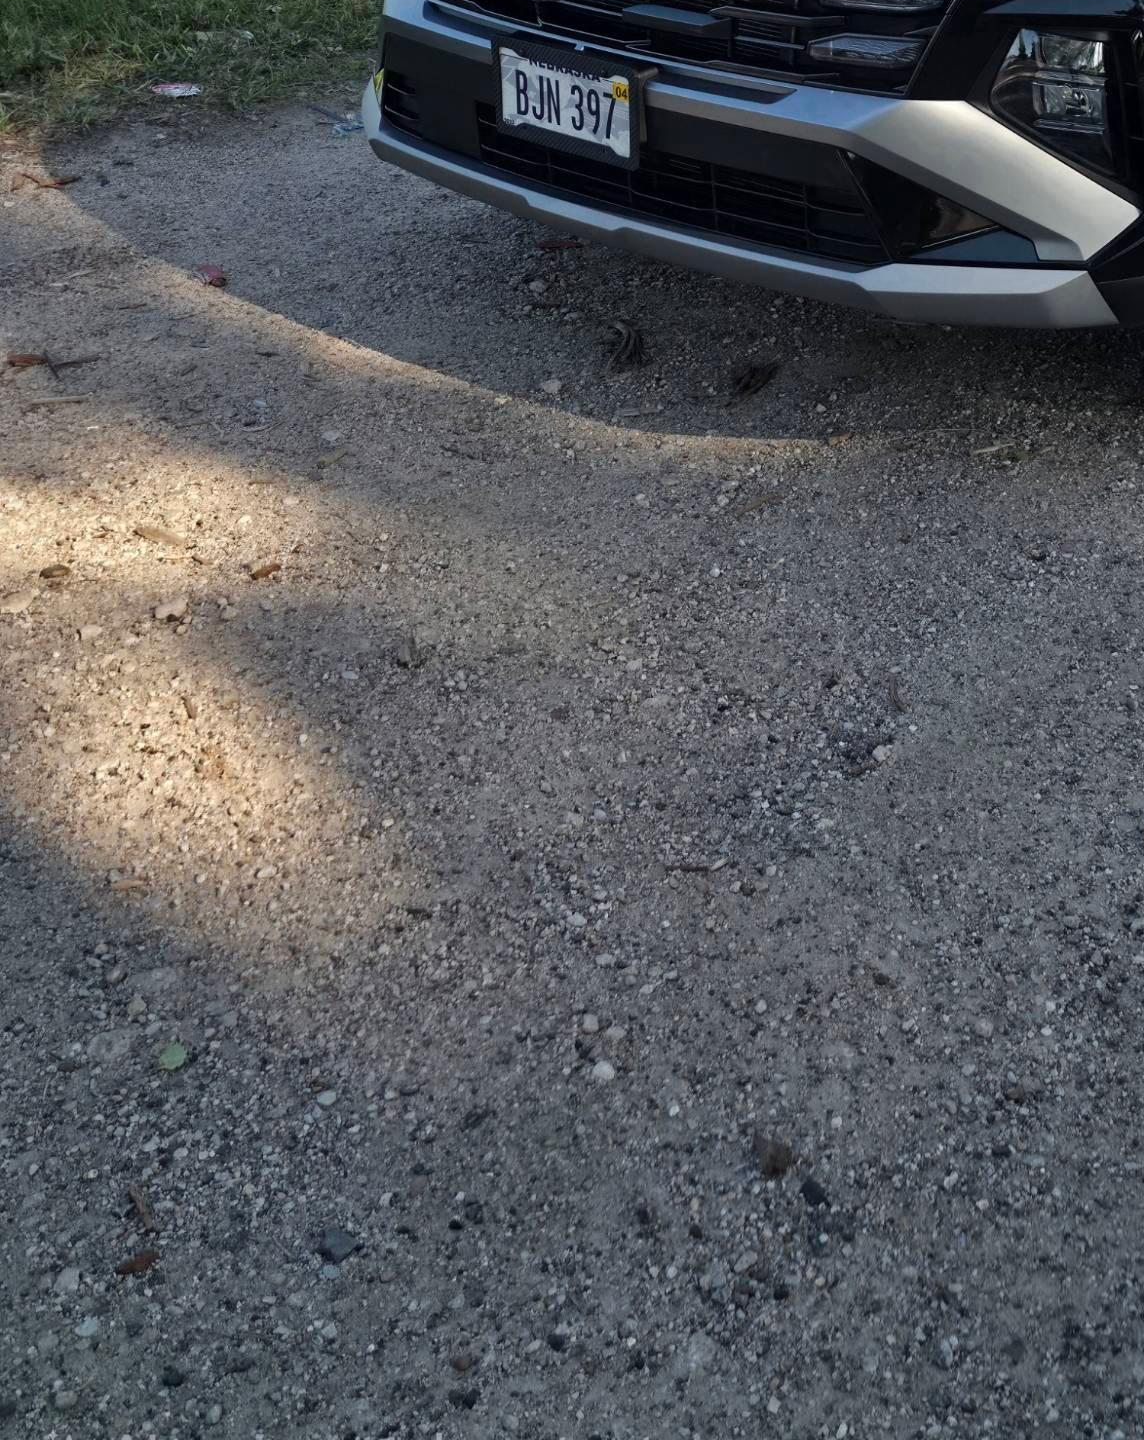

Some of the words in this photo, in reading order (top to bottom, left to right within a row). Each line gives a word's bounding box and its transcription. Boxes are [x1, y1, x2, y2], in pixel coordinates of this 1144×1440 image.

[516, 69, 560, 125] BJN
[571, 84, 616, 139] 397
[616, 86, 628, 100] 04
